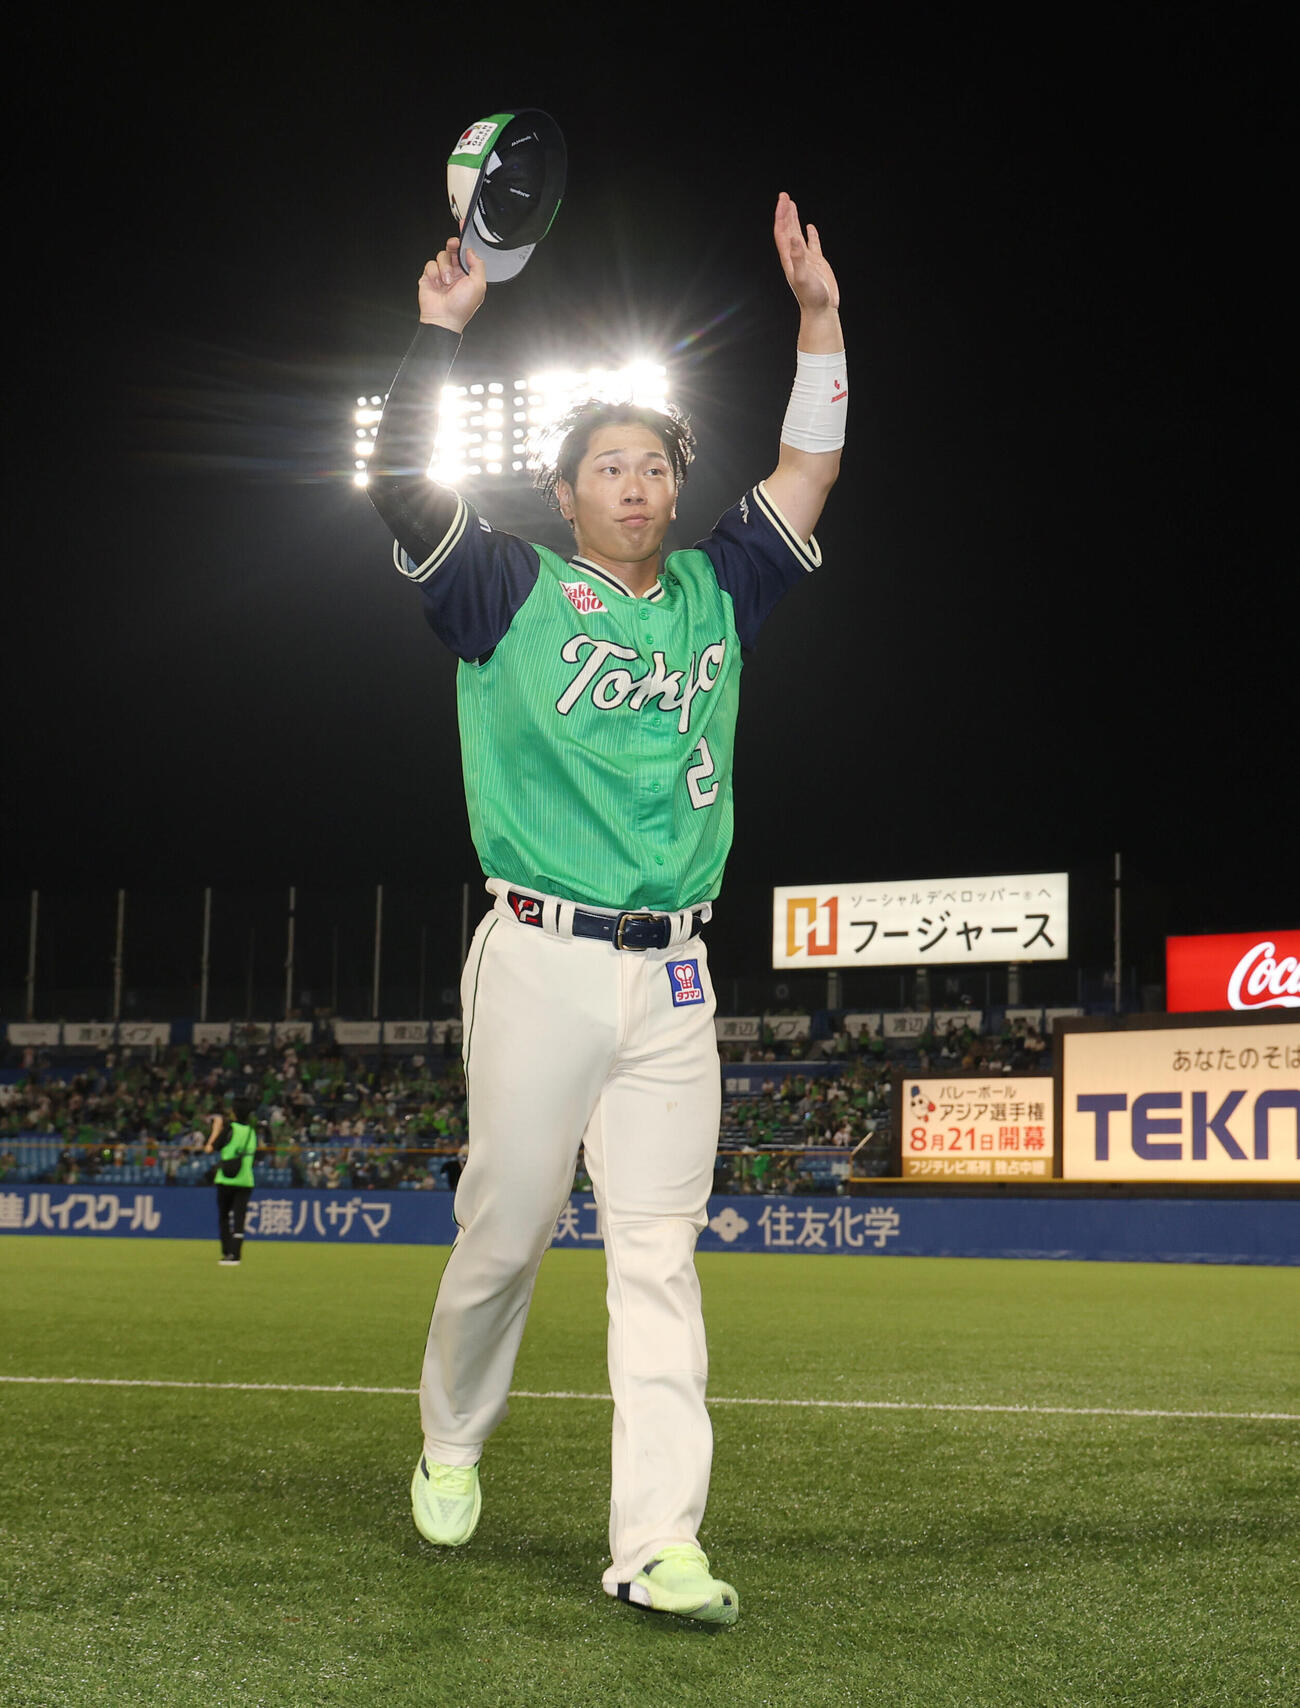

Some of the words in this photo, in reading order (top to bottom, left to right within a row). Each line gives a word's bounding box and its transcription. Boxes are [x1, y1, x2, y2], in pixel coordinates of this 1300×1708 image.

[555, 633, 726, 734] Tokyo
[685, 735, 719, 810] 2
[850, 911, 1055, 953] フージャース
[676, 989, 702, 1001] タフマン
[939, 1086, 1016, 1099] バレーボール
[910, 1126, 1045, 1151] 8月21日開幕
[757, 1205, 900, 1248] 住友化学
